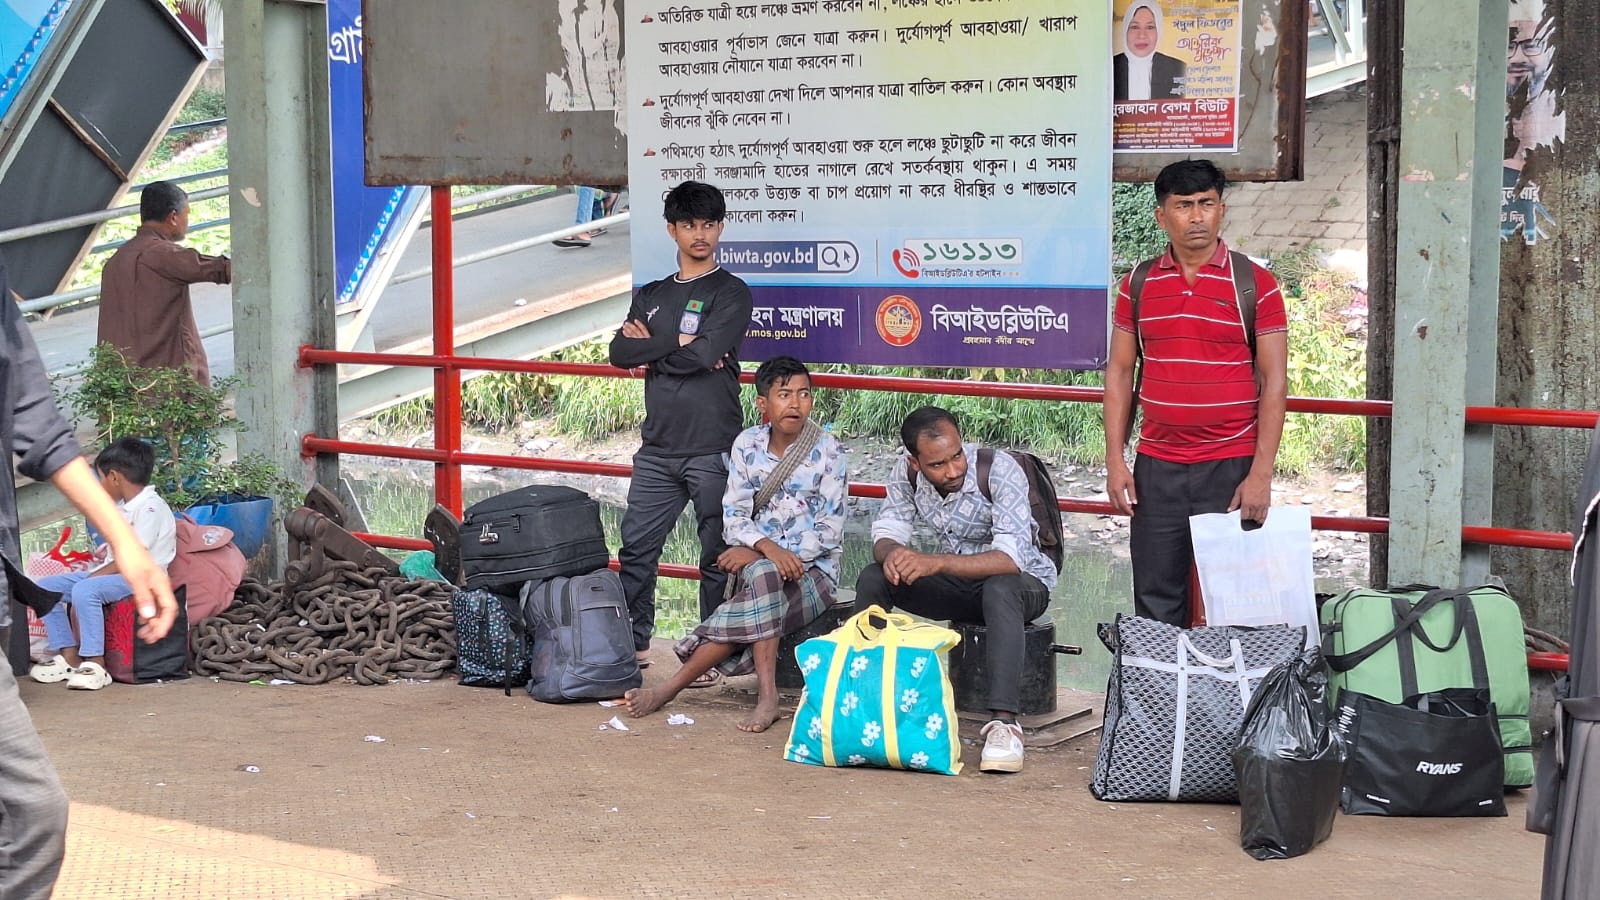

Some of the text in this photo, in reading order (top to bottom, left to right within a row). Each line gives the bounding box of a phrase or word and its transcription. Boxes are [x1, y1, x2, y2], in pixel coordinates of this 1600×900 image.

[658, 6, 703, 24] অতিরিক্ত
[708, 2, 731, 21] যাত্রী
[736, 5, 757, 20] হয়ে
[761, 3, 787, 18] লঞ্চে
[792, 0, 818, 16] ভ্রমণ
[823, 0, 863, 13] করবেন
[658, 38, 718, 55] আবহাওয়ার
[726, 33, 768, 57] পূর্বাভাস
[776, 33, 806, 48] জেনে
[814, 31, 839, 46] যাত্রা
[896, 19, 952, 44] দুর্যোগপূর্ণ
[1040, 16, 1078, 33] খারাপ
[659, 61, 718, 78] আবহাওয়ায়
[722, 56, 763, 74] নৌযানে
[768, 58, 792, 72] যাত্রা
[796, 54, 838, 70] করবেন
[660, 88, 708, 113] দুর্যোগপূর্ণ
[712, 90, 765, 106] আবহাওয়া
[768, 88, 794, 102] দেখা
[798, 84, 825, 102] দিলে
[829, 84, 874, 100] আপনার
[878, 84, 904, 98] যাত্রা
[908, 77, 946, 97] বাতিল
[997, 77, 1028, 93] কোন
[1032, 75, 1078, 94] অবস্থায়
[1161, 102, 1192, 114] বেগম
[1194, 98, 1230, 114] বিউটি
[660, 112, 700, 130] জীবনের
[705, 110, 728, 130] ঝুঁকি
[732, 112, 766, 127] নেবেন
[660, 128, 1078, 160] পথিমধ্যে হঠাৎ দুর্যোগপূর্ণ আবহাওয়া শুরু হলে লঞ্চে ছুটাছুটি না করে জীবন
[660, 163, 707, 181] রক্ষাকারী
[714, 162, 766, 180] সরঞ্জামাদি
[774, 164, 809, 178] হাতের
[818, 162, 856, 177] নাগালে
[865, 162, 893, 176] রেখে
[1026, 158, 1037, 172] এ
[1046, 157, 1077, 172] সময়
[808, 187, 820, 200] বা
[826, 185, 848, 200] চাপ
[854, 185, 892, 200] প্রয়োগ
[899, 184, 912, 198] না
[919, 184, 946, 198] করে
[954, 178, 996, 200] ধীরস্থির
[1004, 182, 1014, 195] ও
[1022, 182, 1078, 197] শান্তভাবে
[725, 210, 762, 224] কাবেলা
[712, 248, 814, 268] .biwta.gov.bd
[923, 242, 1017, 261] ১৬১১৩
[976, 268, 1001, 279] হটলাইন
[778, 305, 845, 328] মন্ত্রণালয়
[930, 304, 1069, 334] বিআইডব্লিউটিএ
[745, 328, 807, 340] .mos.gov.bd
[1416, 760, 1464, 775] RYANS
